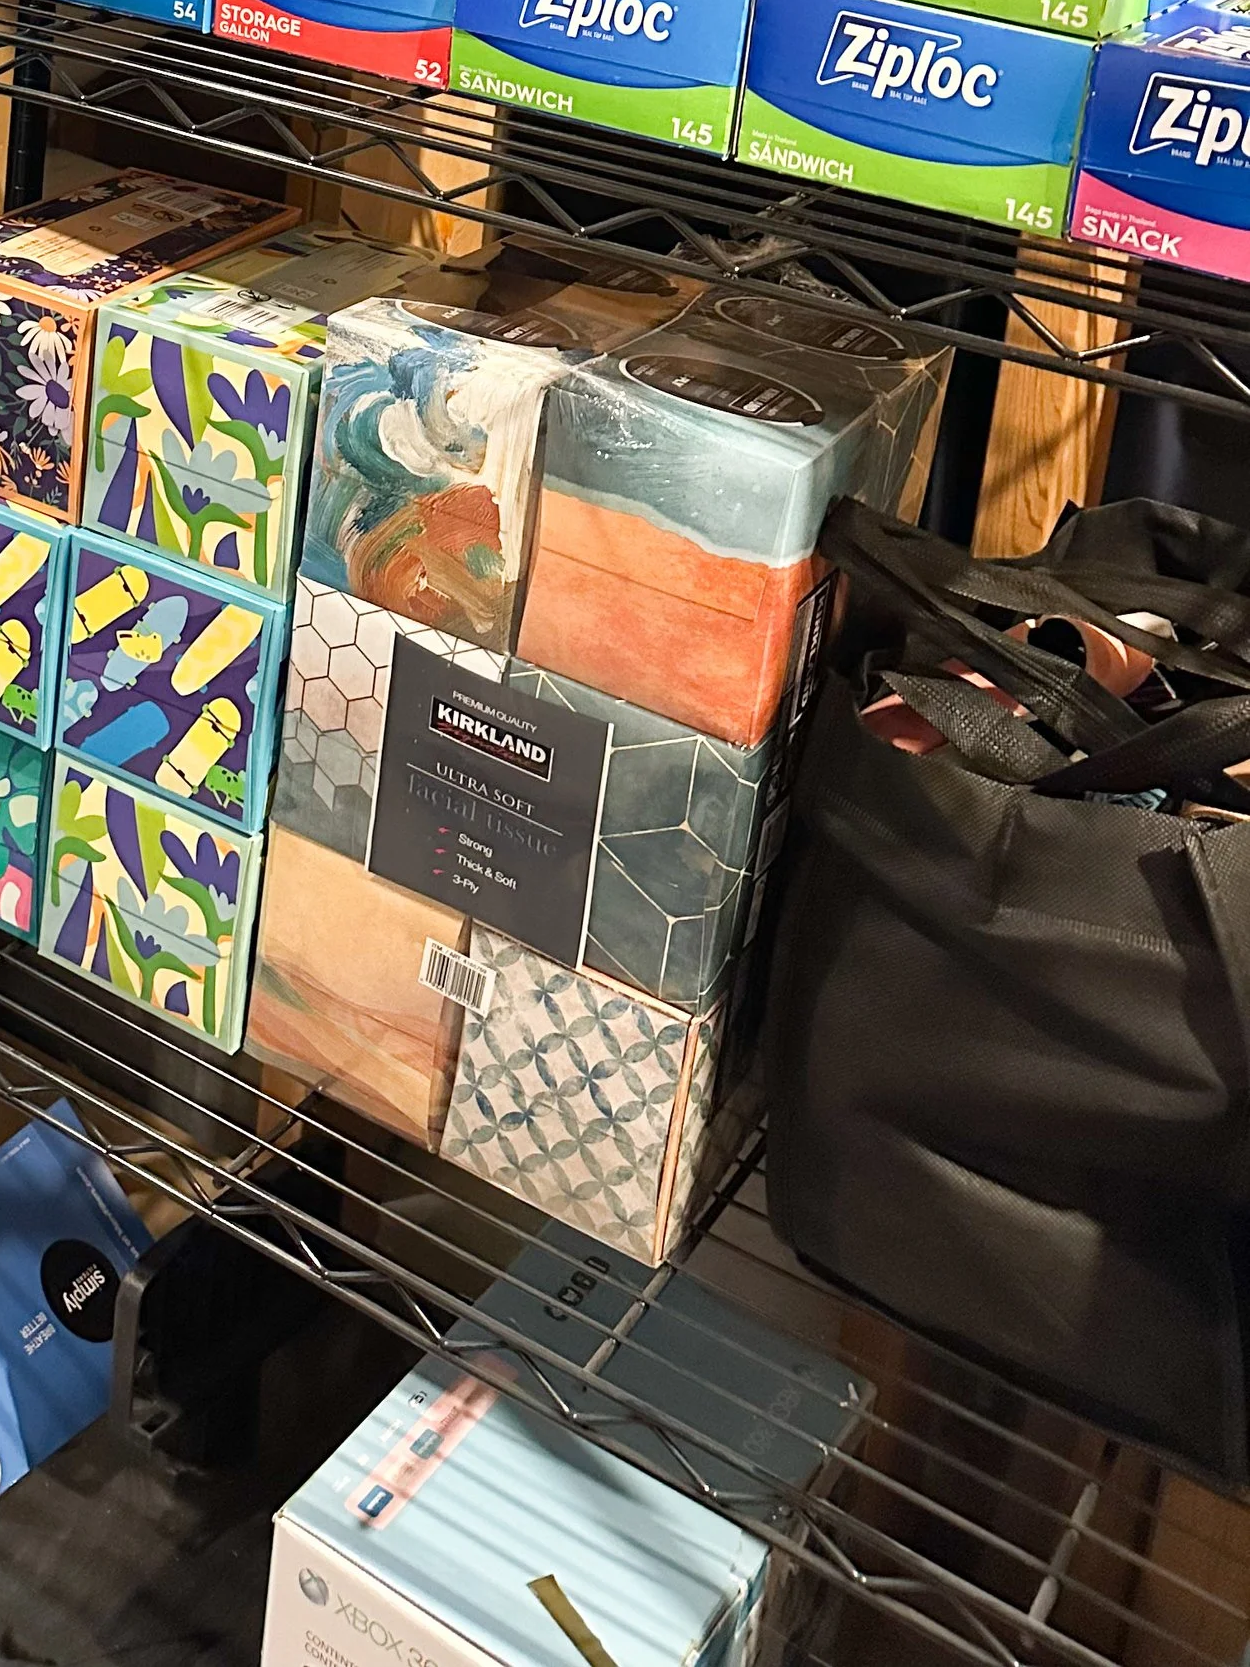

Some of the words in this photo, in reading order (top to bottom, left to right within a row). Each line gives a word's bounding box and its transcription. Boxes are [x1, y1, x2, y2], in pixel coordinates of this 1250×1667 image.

[172, 0, 197, 23] 54
[220, 2, 302, 37] STORAGE
[218, 20, 271, 44] GALLON
[414, 59, 442, 83] 52
[835, 22, 997, 107] Ziploc
[459, 71, 574, 113] SANDWICH
[671, 116, 713, 146] 145
[1004, 197, 1054, 231] 145
[1080, 215, 1183, 259] SNACK
[452, 690, 496, 717] PREMIUM
[494, 709, 538, 734] QUALITY
[437, 702, 547, 764] KIRKLAND
[435, 762, 489, 796] ULTRA
[493, 788, 536, 817] SOFT
[407, 772, 478, 822] facial
[486, 812, 557, 857] tissue
[458, 833, 494, 859] Strong
[452, 873, 481, 895] 3-Ply
[456, 853, 484, 875] Thick
[484, 866, 494, 879] &
[494, 871, 518, 891] Soft
[62, 1269, 106, 1314] simply
[335, 1593, 405, 1661] XBOX
